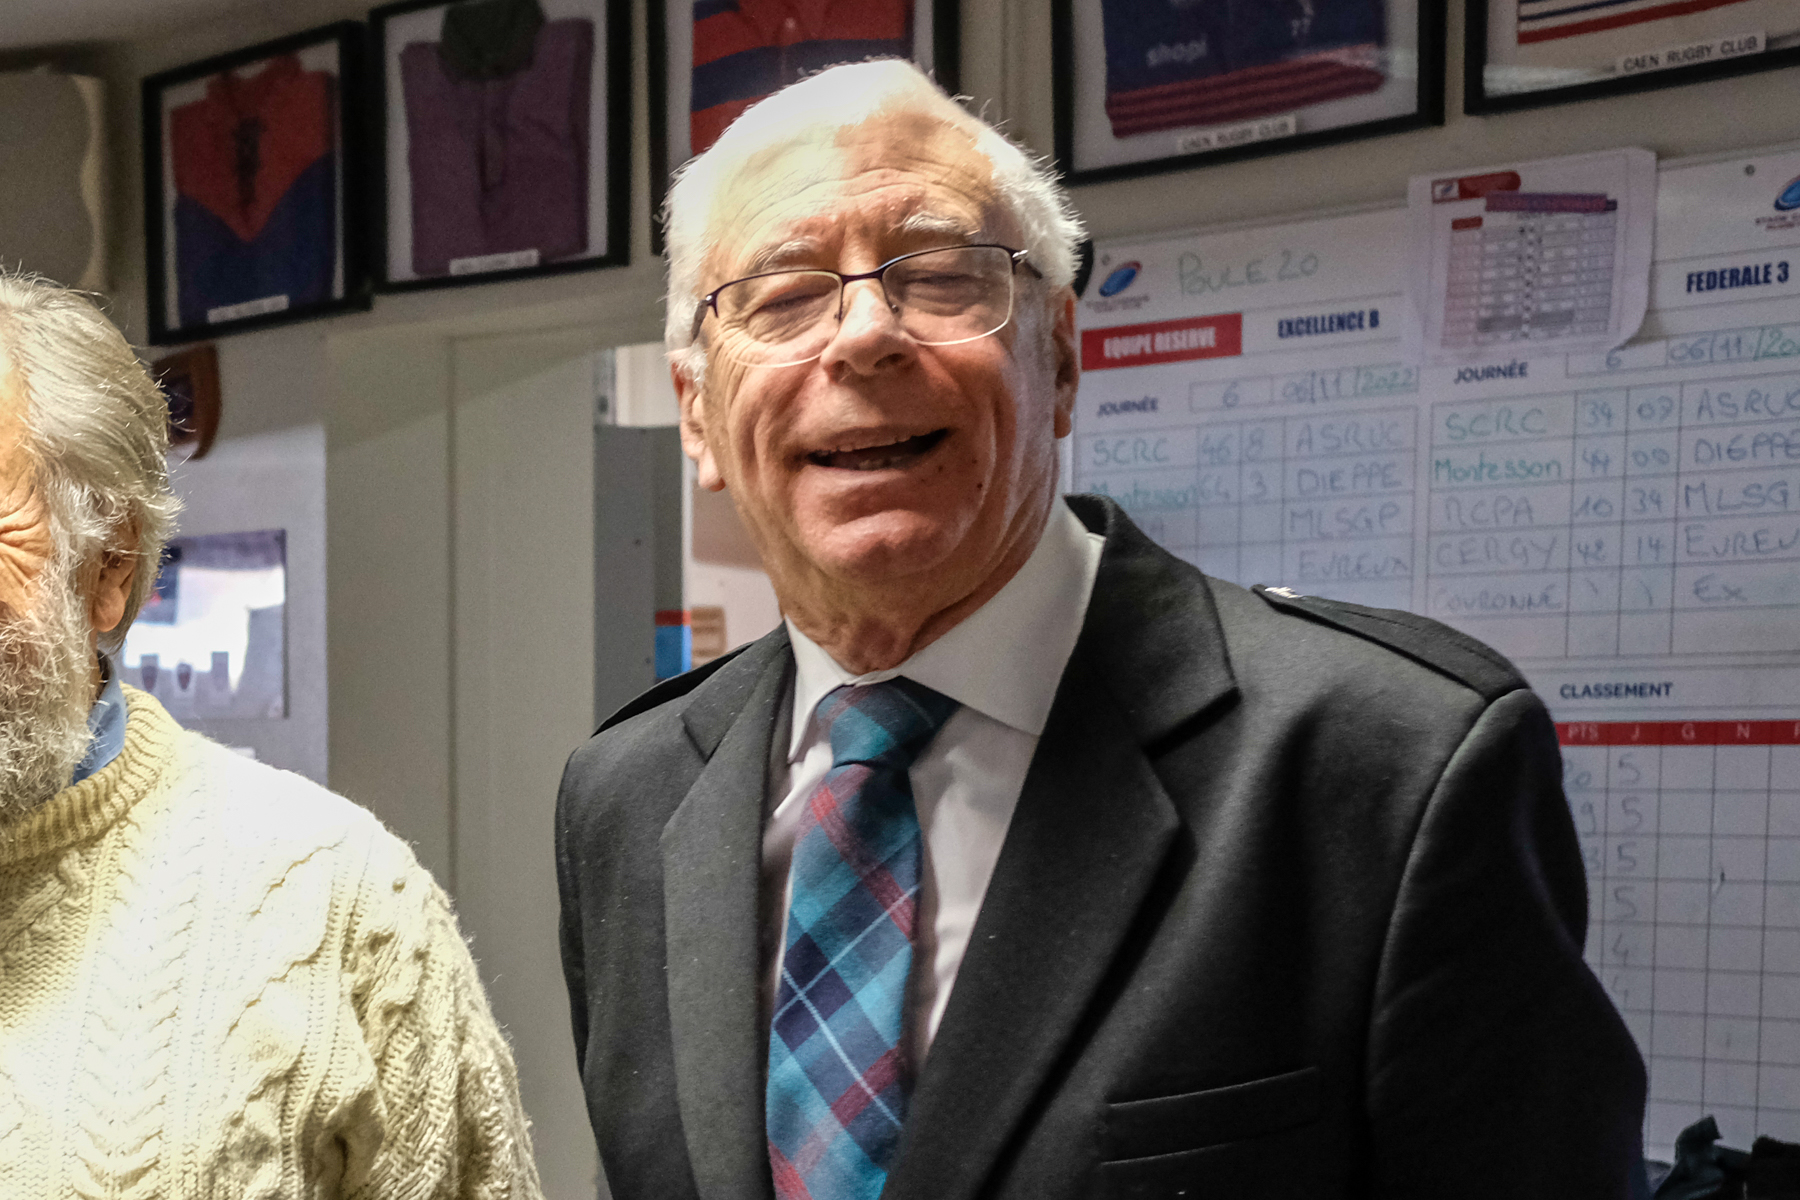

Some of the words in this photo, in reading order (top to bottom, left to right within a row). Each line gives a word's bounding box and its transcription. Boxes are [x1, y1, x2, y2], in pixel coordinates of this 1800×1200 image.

[1623, 53, 1659, 72] CAEN
[1665, 43, 1713, 64] RUGBY
[1720, 36, 1758, 55] CLUB
[1277, 249, 1319, 283] 20
[1686, 262, 1773, 294] FEDERALE
[1777, 260, 1790, 284] 3
[1277, 310, 1365, 340] EXCELLENCE
[1103, 332, 1152, 360] EQUIPE
[1154, 326, 1216, 352] RESERVE
[1453, 359, 1529, 385] JOURNÉE
[1097, 395, 1158, 416] JOURNÉE
[1222, 381, 1240, 408] 6
[1445, 406, 1546, 441] SCRC
[1092, 437, 1170, 466] SCRC
[1296, 421, 1404, 453] ASRUC
[1297, 461, 1402, 494] DIEPPE
[1434, 451, 1562, 483] Montesson
[1684, 522, 1800, 558] EVREU
[1559, 682, 1674, 700] CLASSEMENT
[1568, 723, 1599, 741] PTS
[1681, 722, 1696, 740] G
[1737, 722, 1750, 740] N
